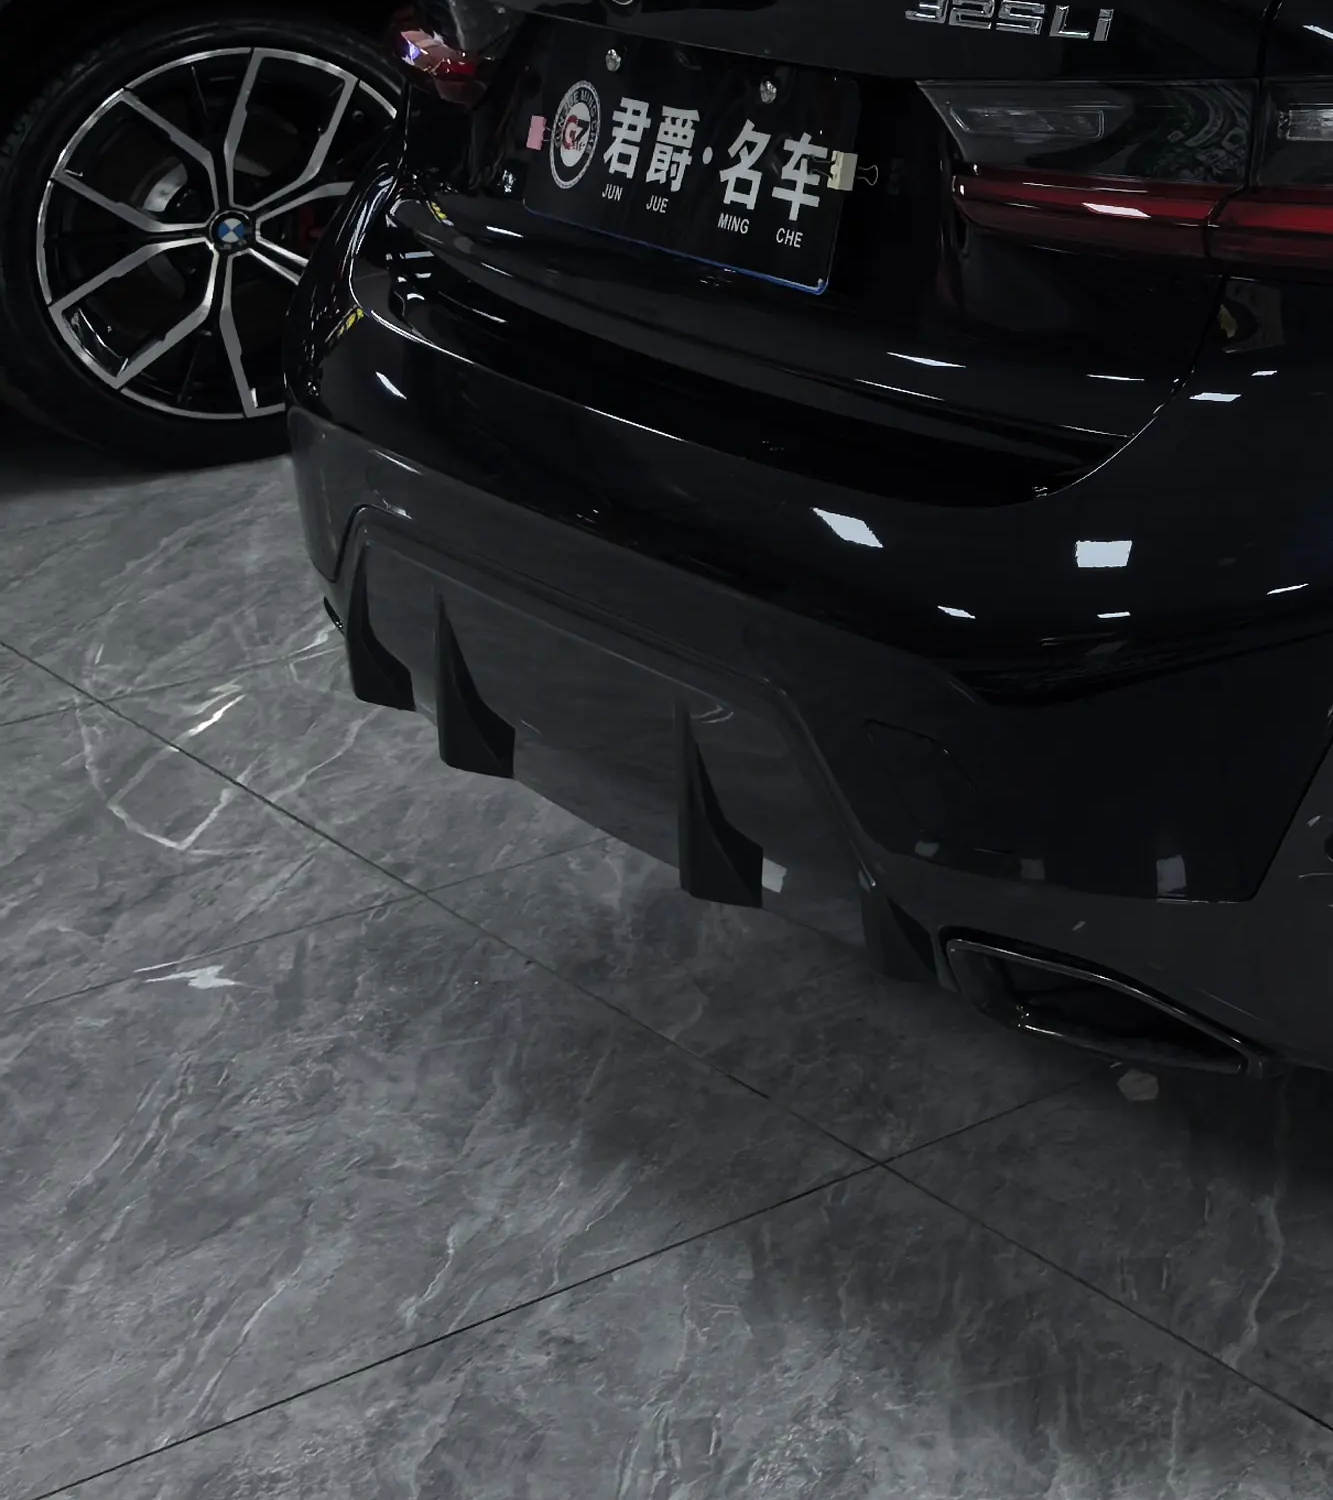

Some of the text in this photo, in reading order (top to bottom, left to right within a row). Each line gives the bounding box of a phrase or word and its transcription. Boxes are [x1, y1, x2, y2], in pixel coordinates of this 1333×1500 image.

[602, 183, 803, 248] JUN JUE MING CHE
